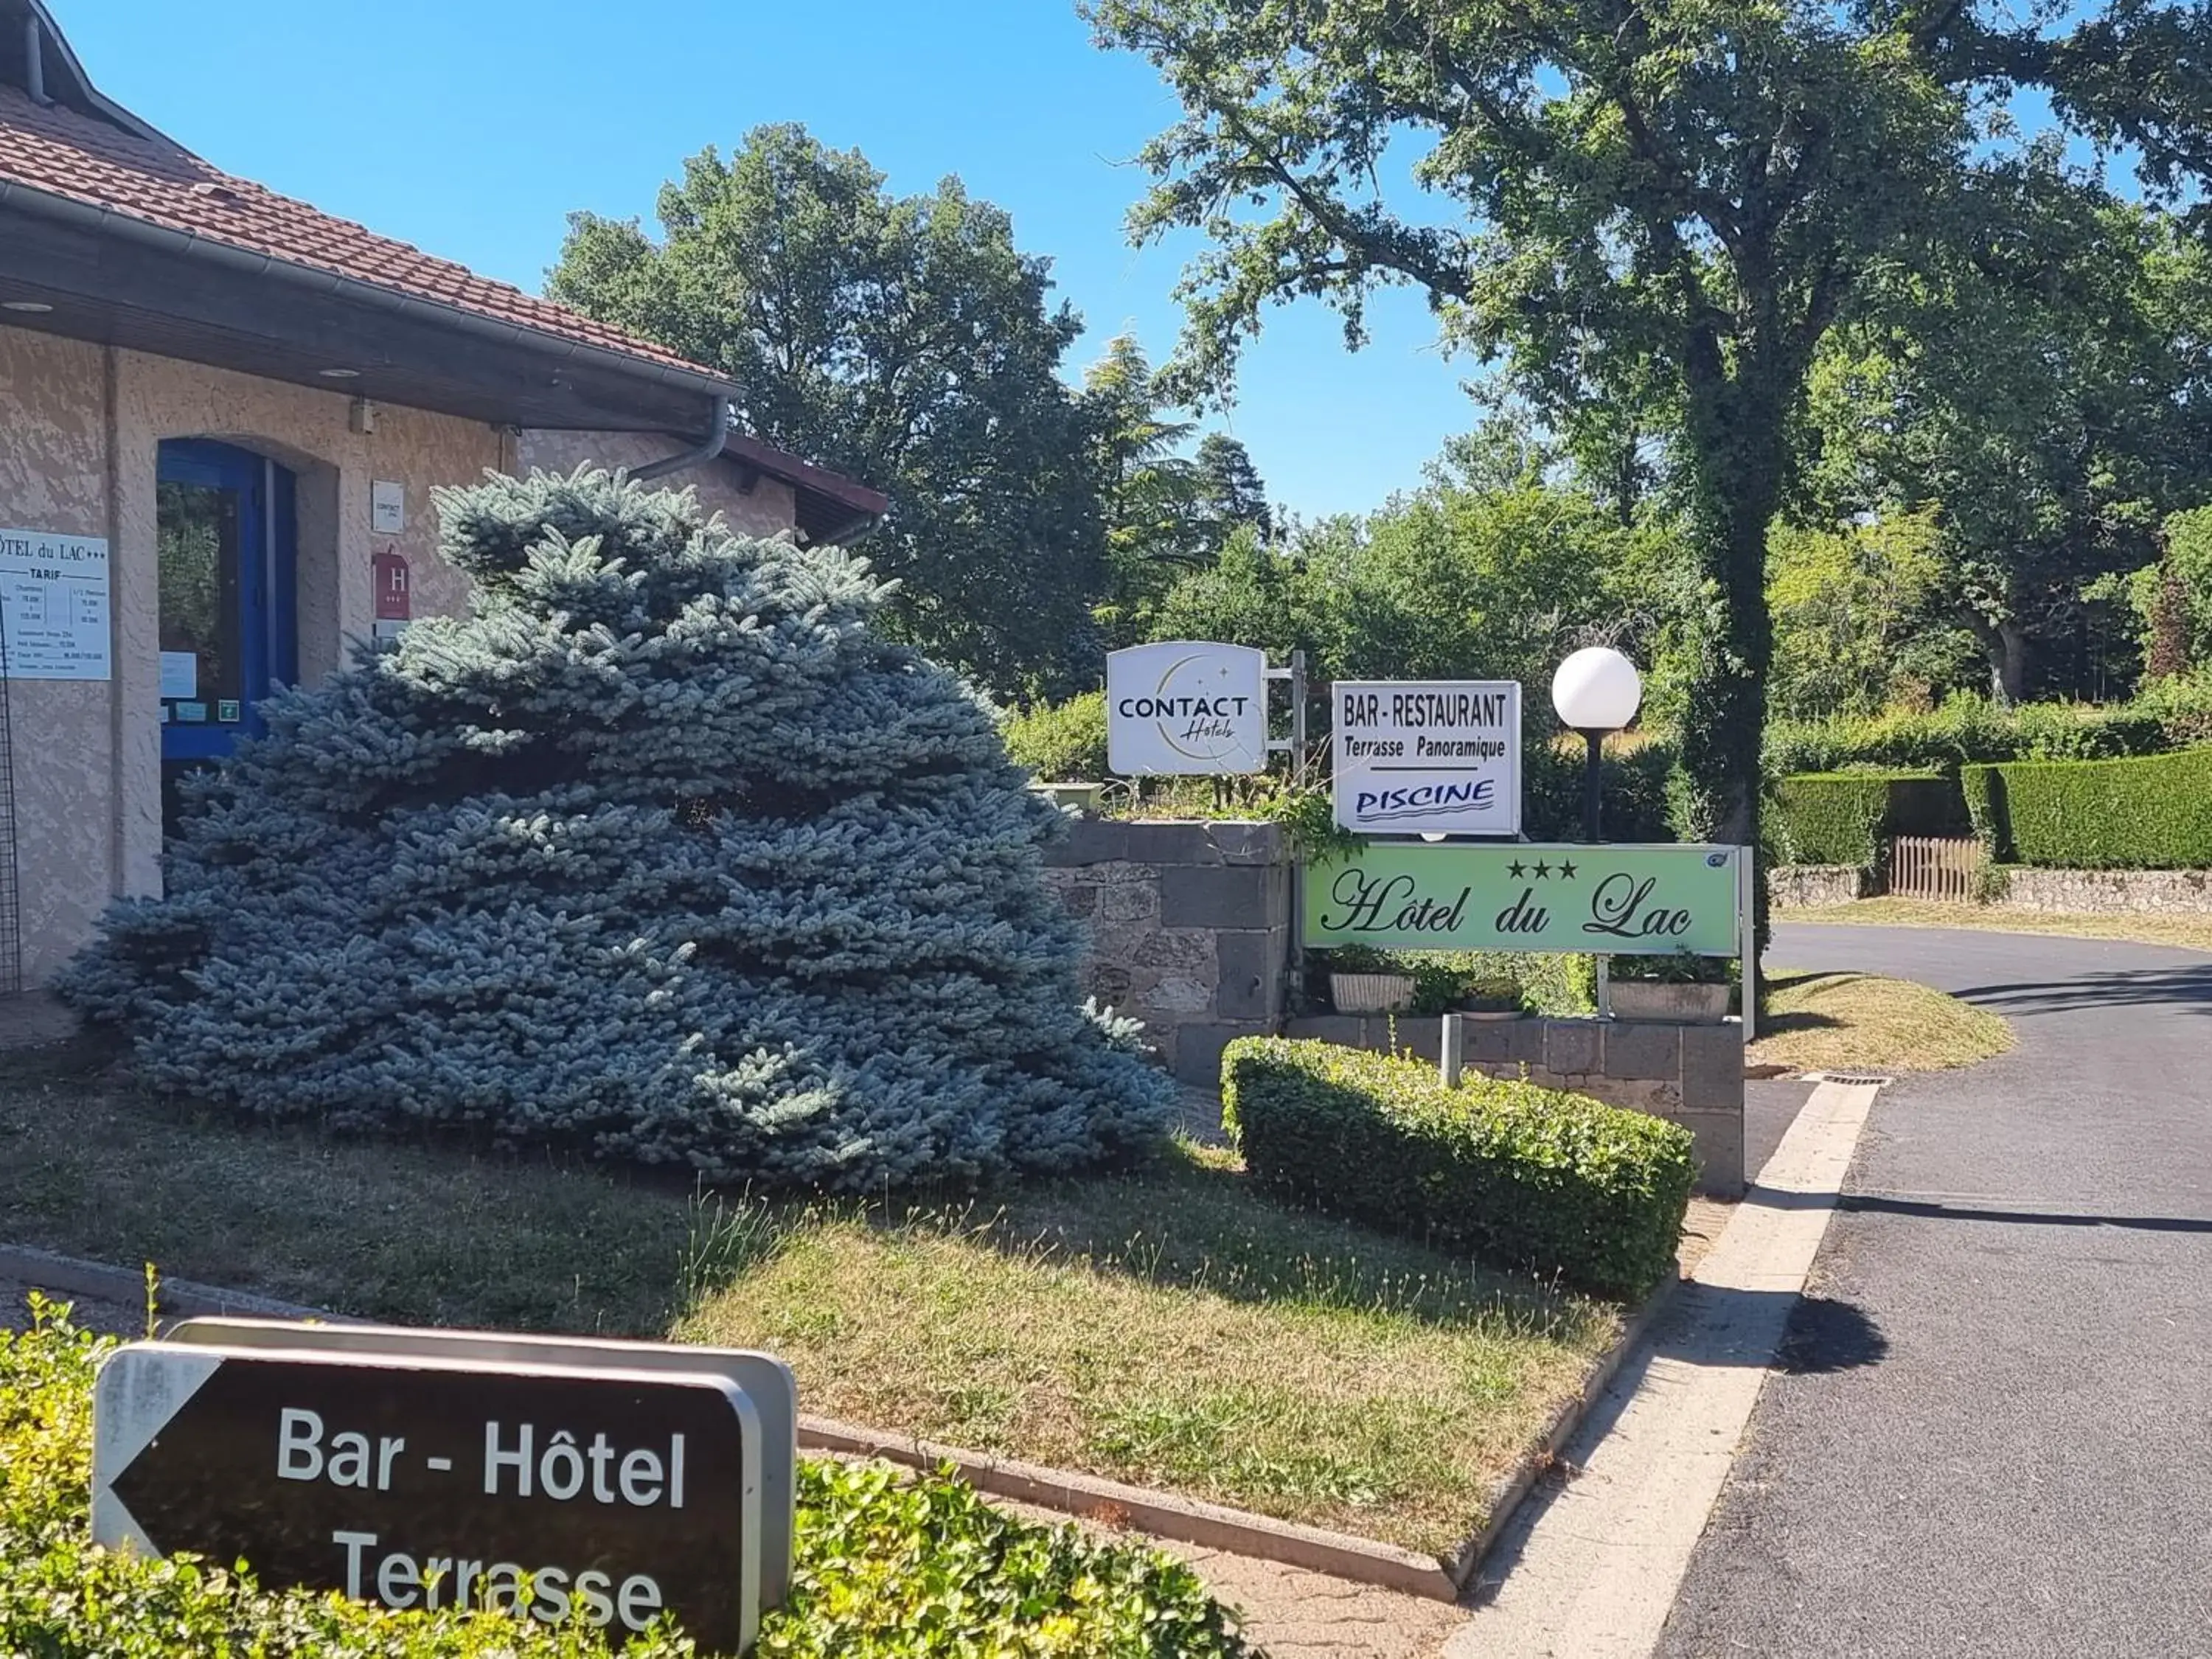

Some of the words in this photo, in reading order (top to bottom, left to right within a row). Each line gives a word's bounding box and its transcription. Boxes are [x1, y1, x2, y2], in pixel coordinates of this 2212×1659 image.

[38, 542, 54, 559] du
[60, 543, 85, 561] LAC
[30, 568, 62, 580] TARIF
[392, 567, 405, 591] H
[1119, 697, 1248, 717] CONTACT
[1344, 694, 1378, 727] BAR
[1393, 694, 1506, 727] RESTAURANT
[1345, 735, 1404, 757] Terrasse
[1416, 736, 1505, 762] Panoramique
[1357, 779, 1495, 813] PISCINE
[1321, 868, 1472, 931] Hôtel
[1495, 887, 1550, 933] du
[1582, 872, 1691, 938] Lac
[277, 1408, 405, 1491] Bar
[428, 1457, 452, 1471] -
[484, 1421, 685, 1509] Hôtel
[333, 1531, 663, 1632] Terrasse
